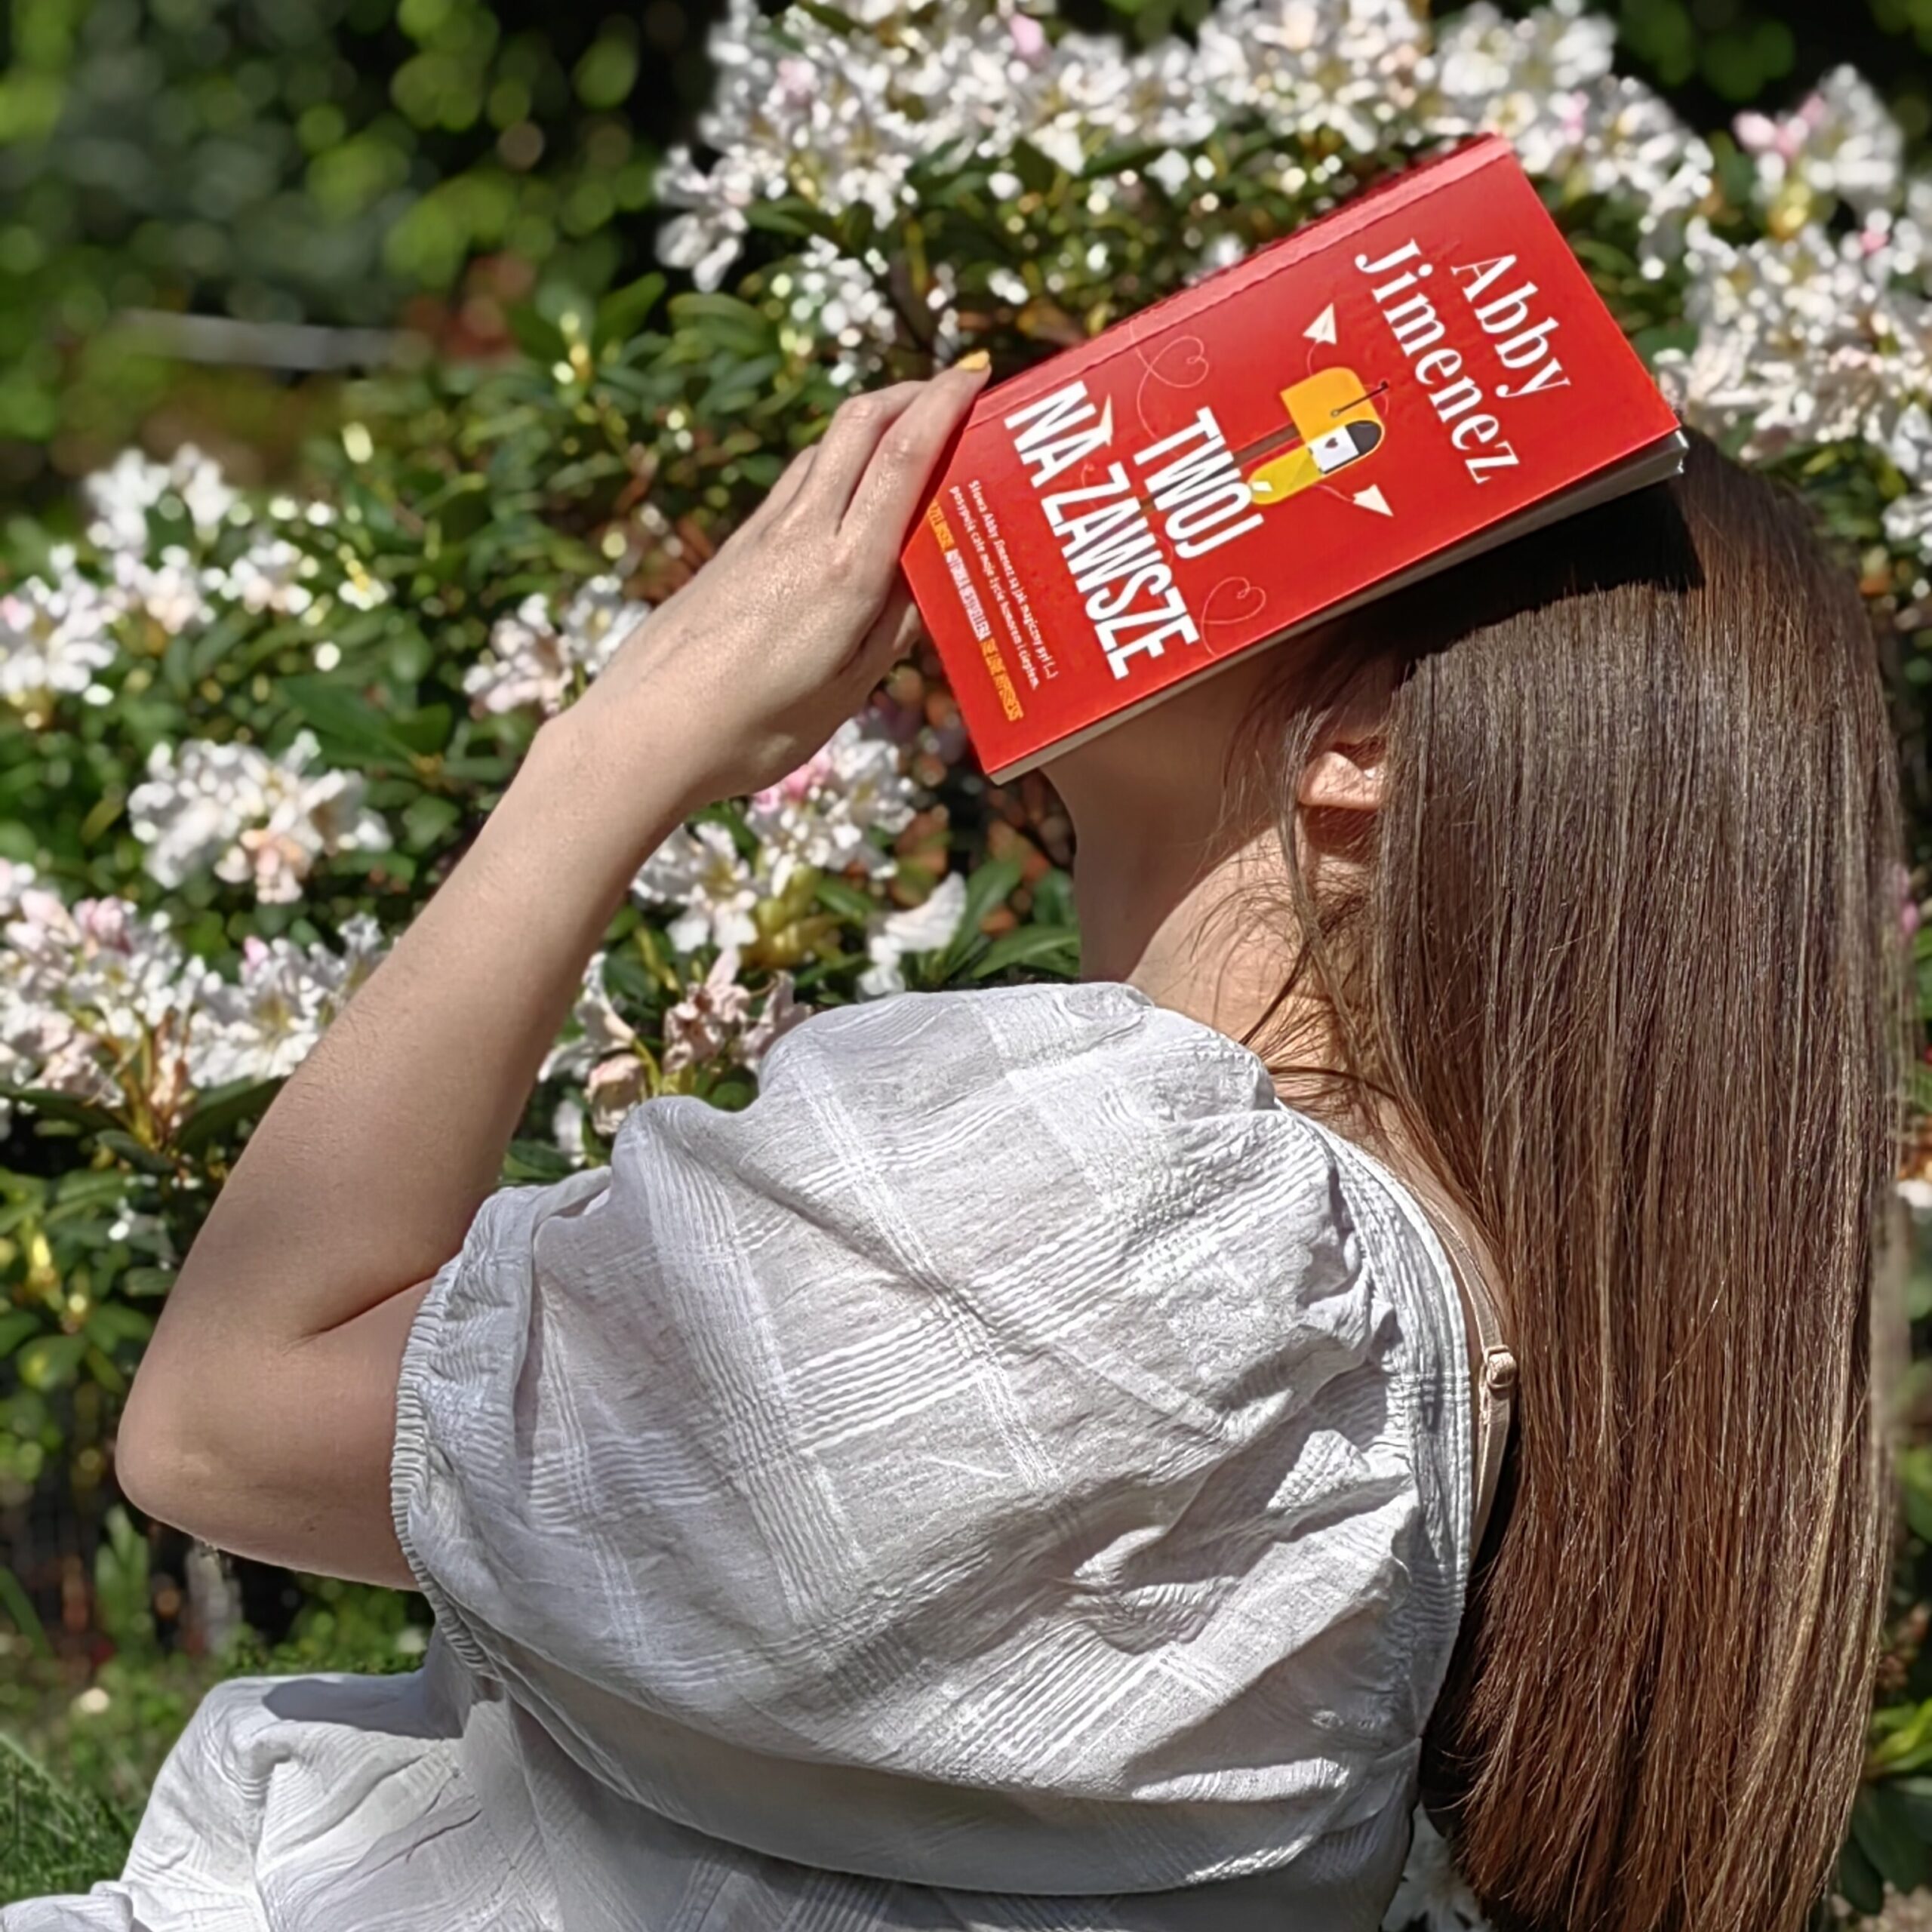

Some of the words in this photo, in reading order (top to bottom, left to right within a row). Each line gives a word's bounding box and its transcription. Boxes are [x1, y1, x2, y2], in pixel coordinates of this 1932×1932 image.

[1355, 238, 1519, 484] Jimenez
[1451, 254, 1571, 397] Abby
[1004, 380, 1112, 488] NA
[1134, 406, 1272, 558] TWÓJ
[1041, 461, 1199, 679] ZAWSZE
